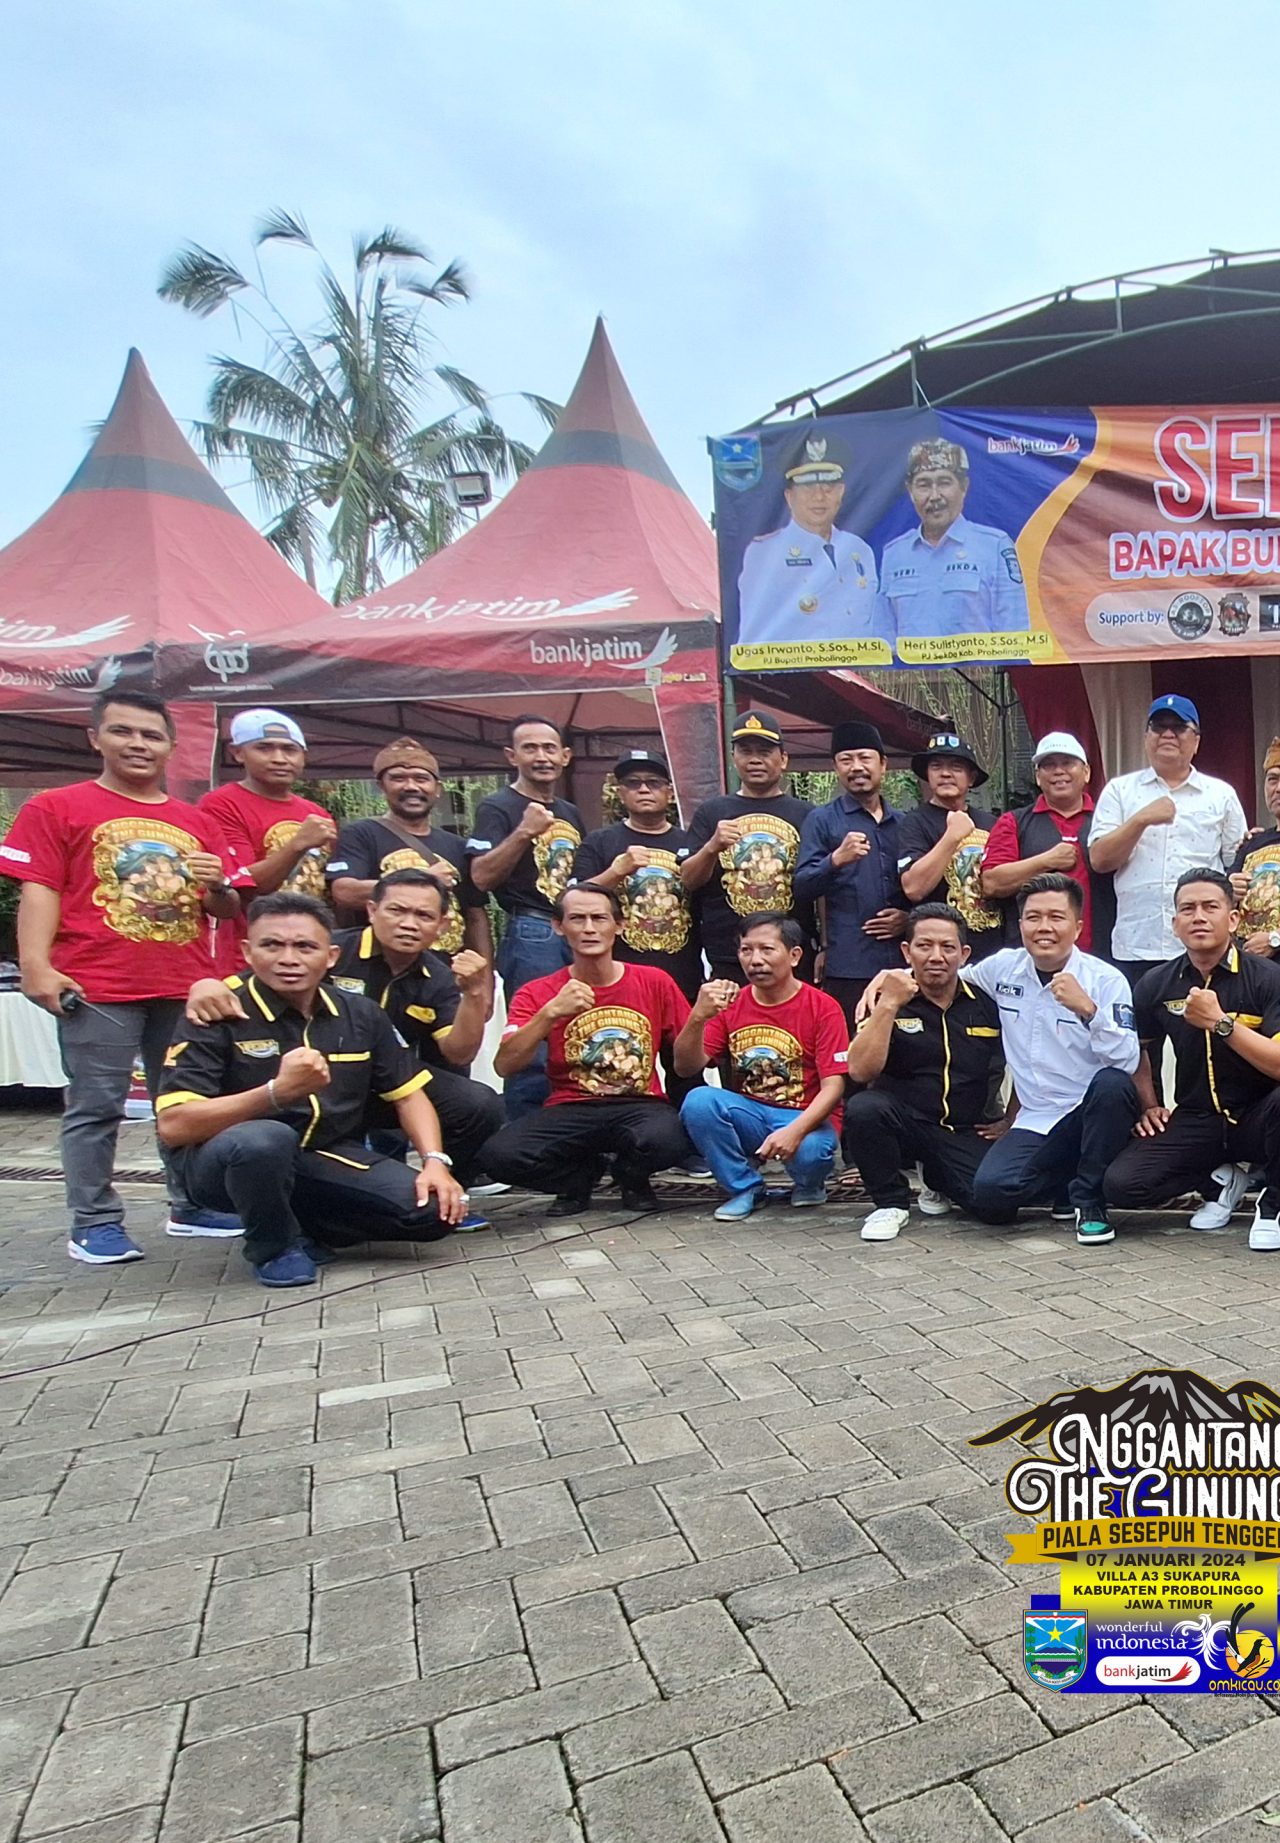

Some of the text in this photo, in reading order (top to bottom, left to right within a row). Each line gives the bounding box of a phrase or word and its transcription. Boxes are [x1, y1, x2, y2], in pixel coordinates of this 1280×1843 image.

[1111, 533, 1229, 578] BAPAK
[1099, 611, 1164, 625] Support by:
[736, 645, 764, 657] Ugas
[767, 644, 815, 656] Irwanto,
[904, 640, 927, 650] Heri
[530, 638, 642, 668] bankjatim
[805, 654, 858, 664] Probolinggo
[977, 648, 1030, 658] Probolinggo
